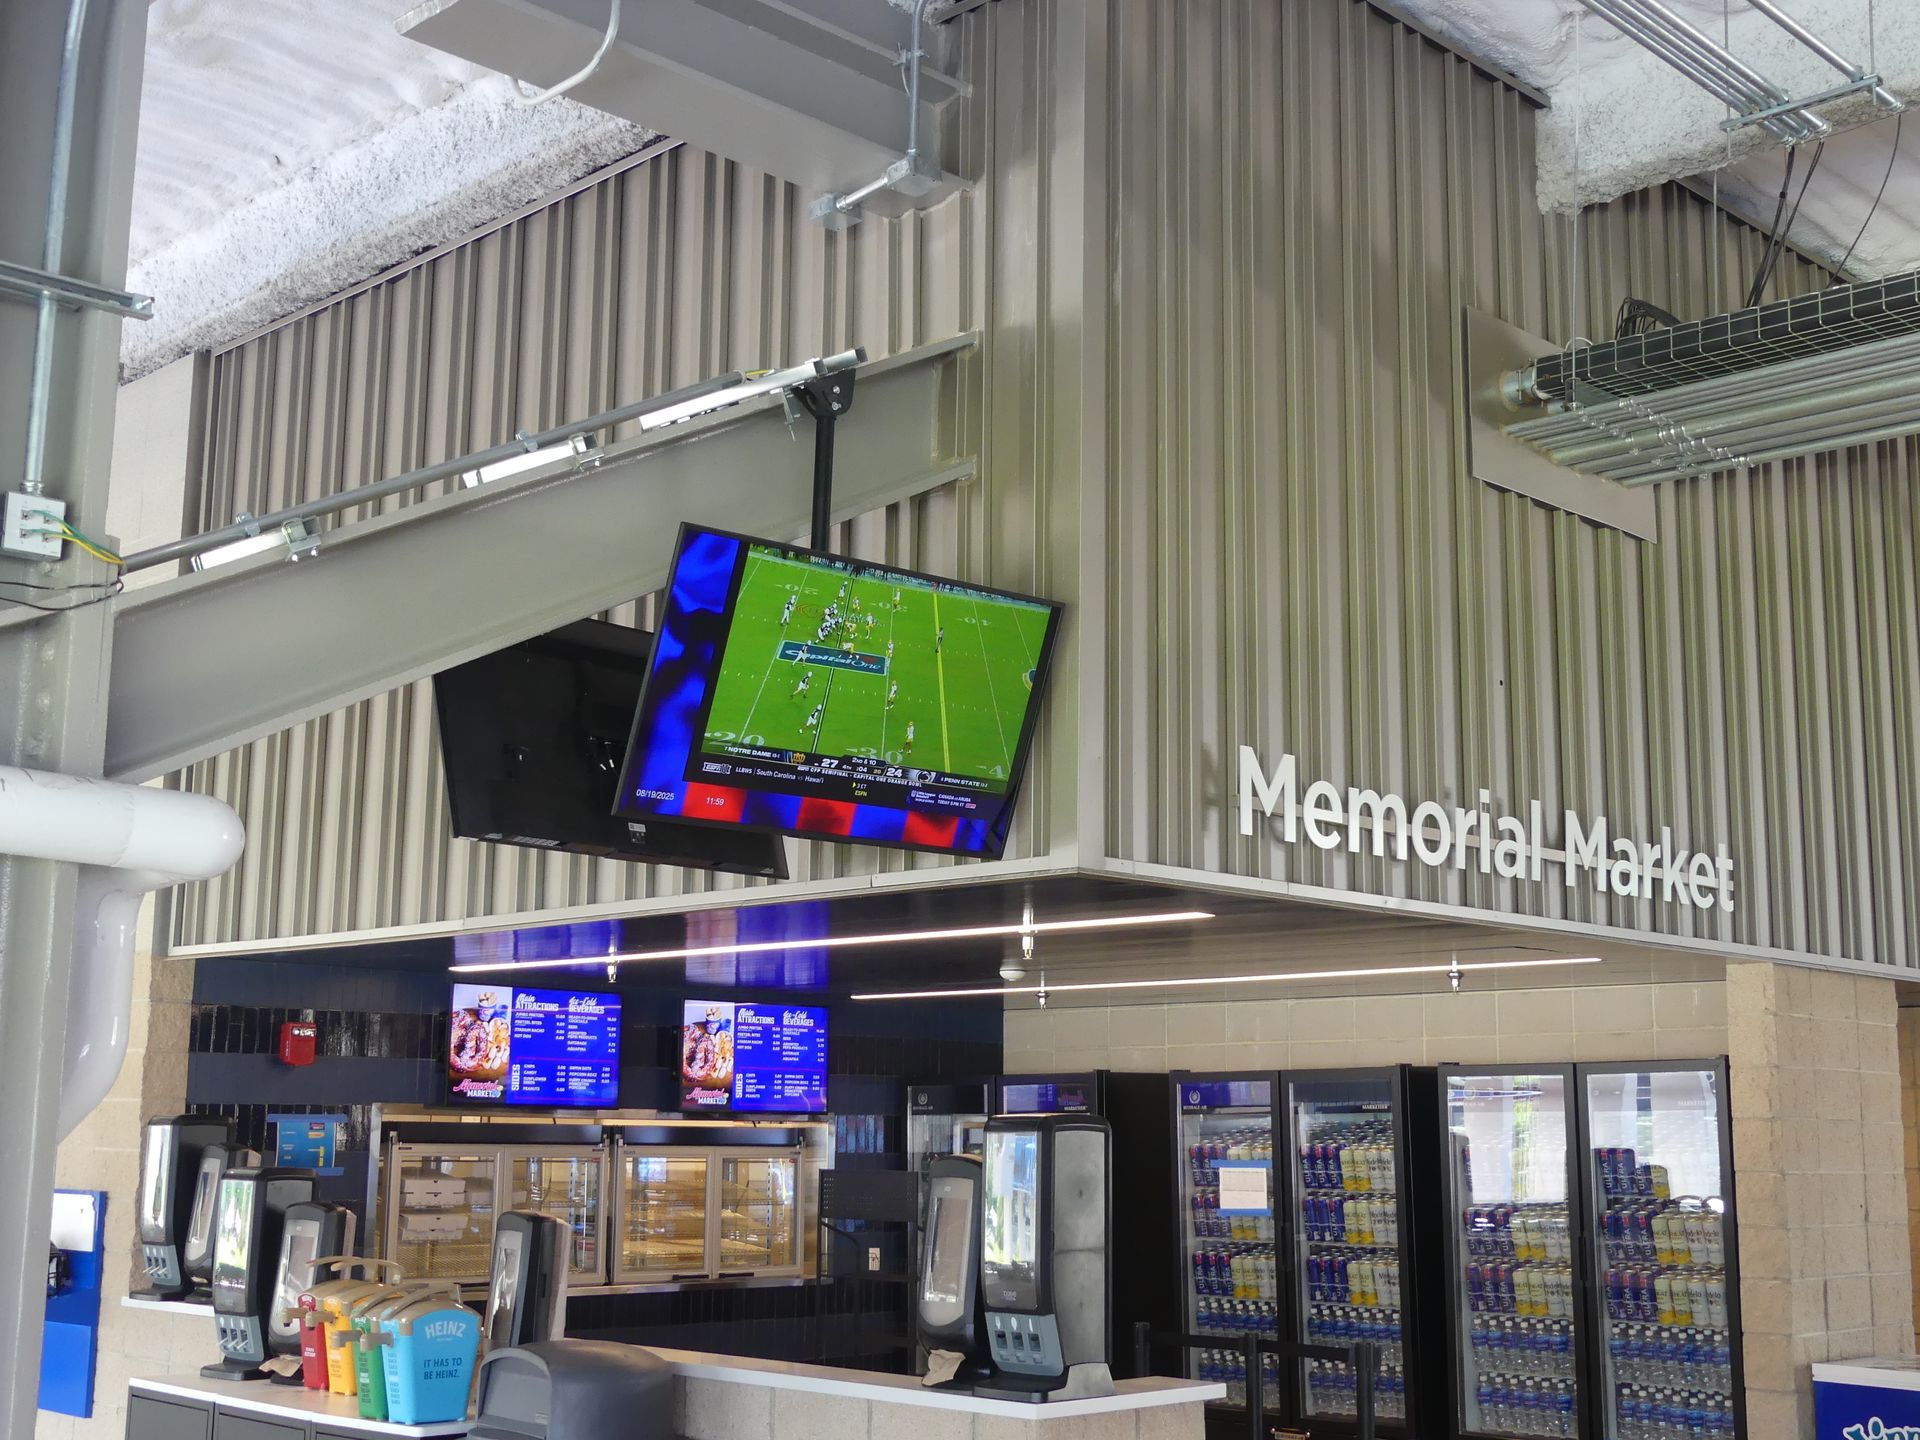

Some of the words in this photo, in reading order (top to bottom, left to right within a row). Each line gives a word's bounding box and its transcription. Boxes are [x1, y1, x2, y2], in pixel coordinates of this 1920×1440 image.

[785, 649, 881, 670] CpitalOne
[728, 747, 751, 755] NOTRE
[752, 750, 771, 758] DAME
[821, 758, 839, 768] 27
[756, 769, 773, 777] South
[773, 771, 796, 780] Carolina
[886, 768, 902, 777] 24
[961, 779, 981, 787] STATE
[636, 789, 675, 800] 08/19/2025
[706, 797, 725, 806] 11:59
[1239, 745, 1541, 882] Memorial
[1565, 809, 1734, 912] Market
[516, 993, 535, 1002] Main
[515, 1000, 559, 1011] ATTRACTIONS
[568, 1004, 605, 1014] BEVERAGES
[737, 1016, 774, 1024] ATTRACTIONS
[782, 1018, 813, 1026] BEVERAGES
[512, 1064, 520, 1091] SIDES
[453, 1079, 499, 1091] Memorial
[1328, 1160, 1337, 1183] ULTRA
[1618, 1162, 1627, 1189] ULTRA
[1625, 1229, 1634, 1255] ULTRA
[1641, 1229, 1651, 1255] ULTRA
[1624, 1289, 1633, 1314] ULTRA
[1642, 1289, 1651, 1315] ULTRA
[424, 1320, 467, 1340] HEINZ
[424, 1359, 432, 1368] IT
[433, 1357, 450, 1368] HAS
[451, 1357, 462, 1366] TO
[424, 1371, 433, 1380] BE
[435, 1369, 460, 1380] HEINZ.
